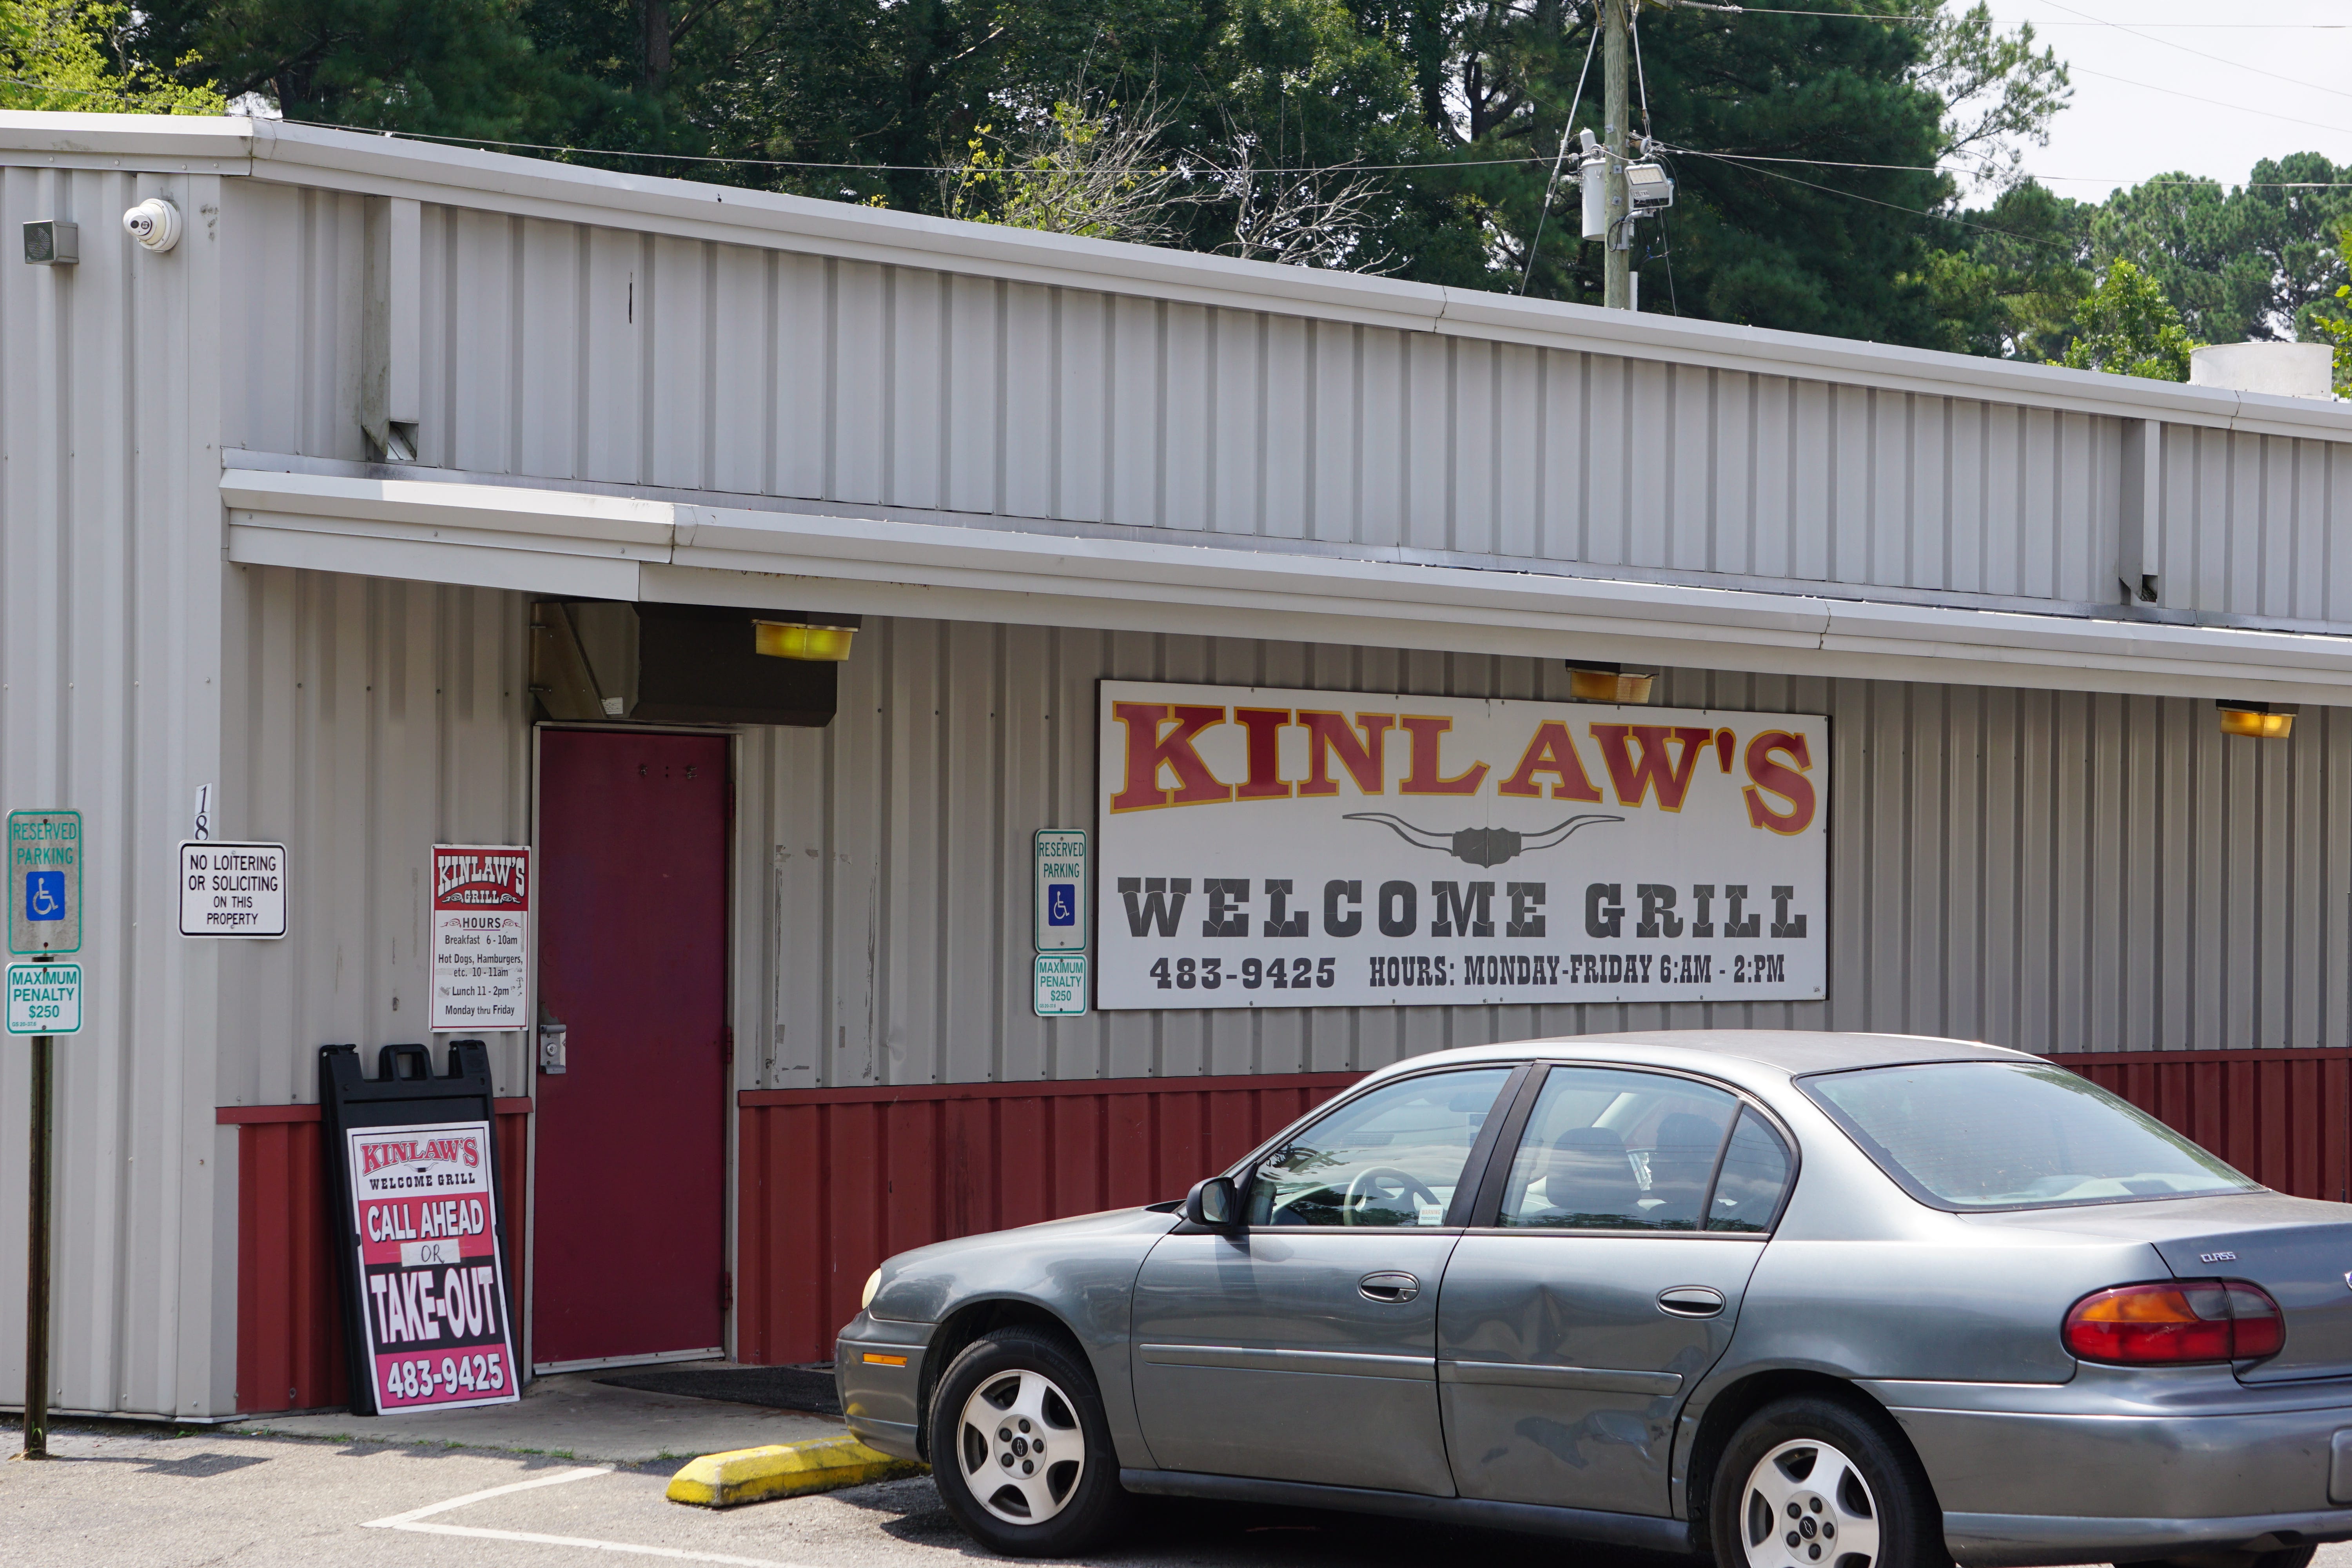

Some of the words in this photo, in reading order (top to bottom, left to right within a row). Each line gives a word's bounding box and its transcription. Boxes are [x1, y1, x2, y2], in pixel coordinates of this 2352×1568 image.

[1109, 700, 1817, 837] KINLAW'S
[13, 823, 77, 841] RESERVED
[17, 847, 73, 865] PARKING
[1039, 842, 1084, 857] RESERVED
[190, 855, 207, 870] NO
[214, 855, 276, 871] LOITERING
[1044, 863, 1080, 878] PARKING
[189, 875, 205, 891] OR
[212, 875, 278, 891] SOLICITING
[438, 856, 525, 897] KINLAW'S
[214, 896, 227, 908] ON
[232, 896, 253, 908] THIS
[464, 890, 499, 904] GRILL
[1117, 877, 1547, 938] WELCOME
[1585, 882, 1808, 939] GRILL
[207, 913, 258, 925] PROPERTY
[463, 917, 501, 929] HOURS
[445, 935, 480, 944] Breakfast
[486, 935, 492, 944] 6
[498, 935, 517, 944] 10am
[438, 954, 452, 964] Hot
[454, 954, 475, 965] Dogs,
[477, 954, 523, 965] Hamburgers,
[454, 968, 468, 977] etc.
[472, 967, 481, 976] 10
[489, 967, 508, 976] 11am
[1039, 962, 1083, 973] MAXIMUM
[1149, 957, 1336, 989] 483-9425
[1369, 955, 1455, 987] HOURS:
[1464, 954, 1651, 986] MONDAY-FRIDAY
[1659, 955, 1712, 984] 6:AM
[1733, 954, 1785, 984] 2:PM
[12, 972, 77, 985] MAXIMUM
[1040, 976, 1081, 987] PENALTY
[13, 987, 74, 1002] PENALTY
[452, 986, 475, 996] Lunch
[477, 986, 486, 996] 11
[494, 986, 509, 997] 2pm
[1051, 989, 1072, 1002] $250
[29, 1005, 60, 1019] $250
[446, 1005, 475, 1016] Monday
[477, 1005, 491, 1014] thru
[493, 1005, 515, 1016] Friday
[360, 1137, 479, 1176] KINLAW'S
[369, 1175, 433, 1191] WELCOME
[437, 1173, 475, 1185] GRILL
[367, 1203, 417, 1242] CALL
[421, 1199, 484, 1238] AHEAD
[421, 1245, 445, 1264] OR
[370, 1267, 495, 1344] TAKE-OUT
[387, 1353, 504, 1399] 483-9425
